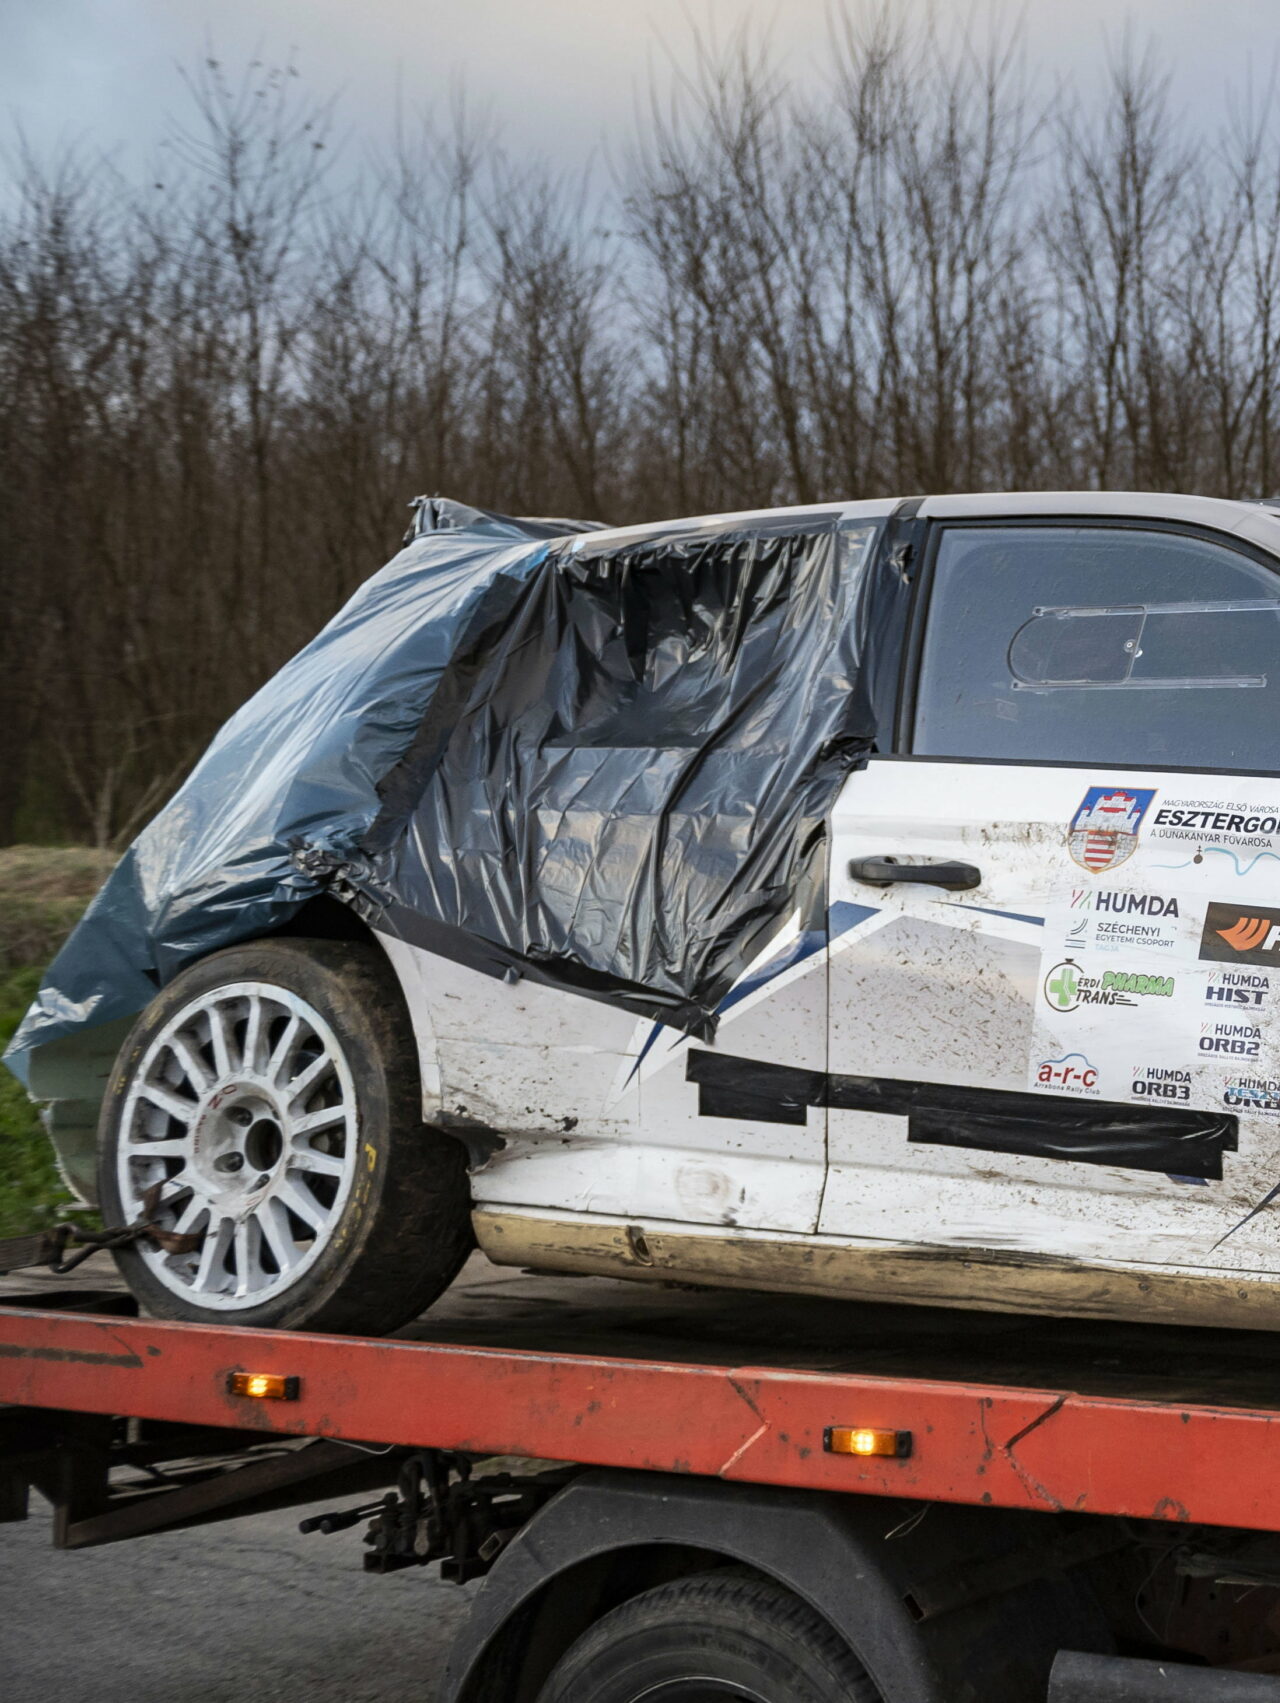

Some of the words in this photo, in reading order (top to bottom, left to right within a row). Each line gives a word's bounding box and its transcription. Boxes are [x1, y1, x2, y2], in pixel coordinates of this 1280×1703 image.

[1162, 799, 1225, 809] MAGYARORSZÁG
[1150, 829, 1157, 837] A
[1159, 829, 1221, 843] DUNAKANYAR
[1095, 891, 1179, 918] HUMDA
[1097, 921, 1160, 937] SZÉCHENYI
[1096, 934, 1135, 944] EGYETEMI
[1136, 938, 1175, 948] CSOPORT
[1101, 971, 1175, 997] PHARMA
[1222, 973, 1270, 989] HUMDA
[1076, 989, 1118, 1006] TRANS
[1206, 986, 1269, 1005] HIST
[1215, 1023, 1262, 1039] HUMDA
[1199, 1036, 1260, 1056] ORB2
[1038, 1064, 1097, 1088] a-r-c
[1146, 1067, 1192, 1084] HUMDA
[1132, 1080, 1190, 1100] ORB3
